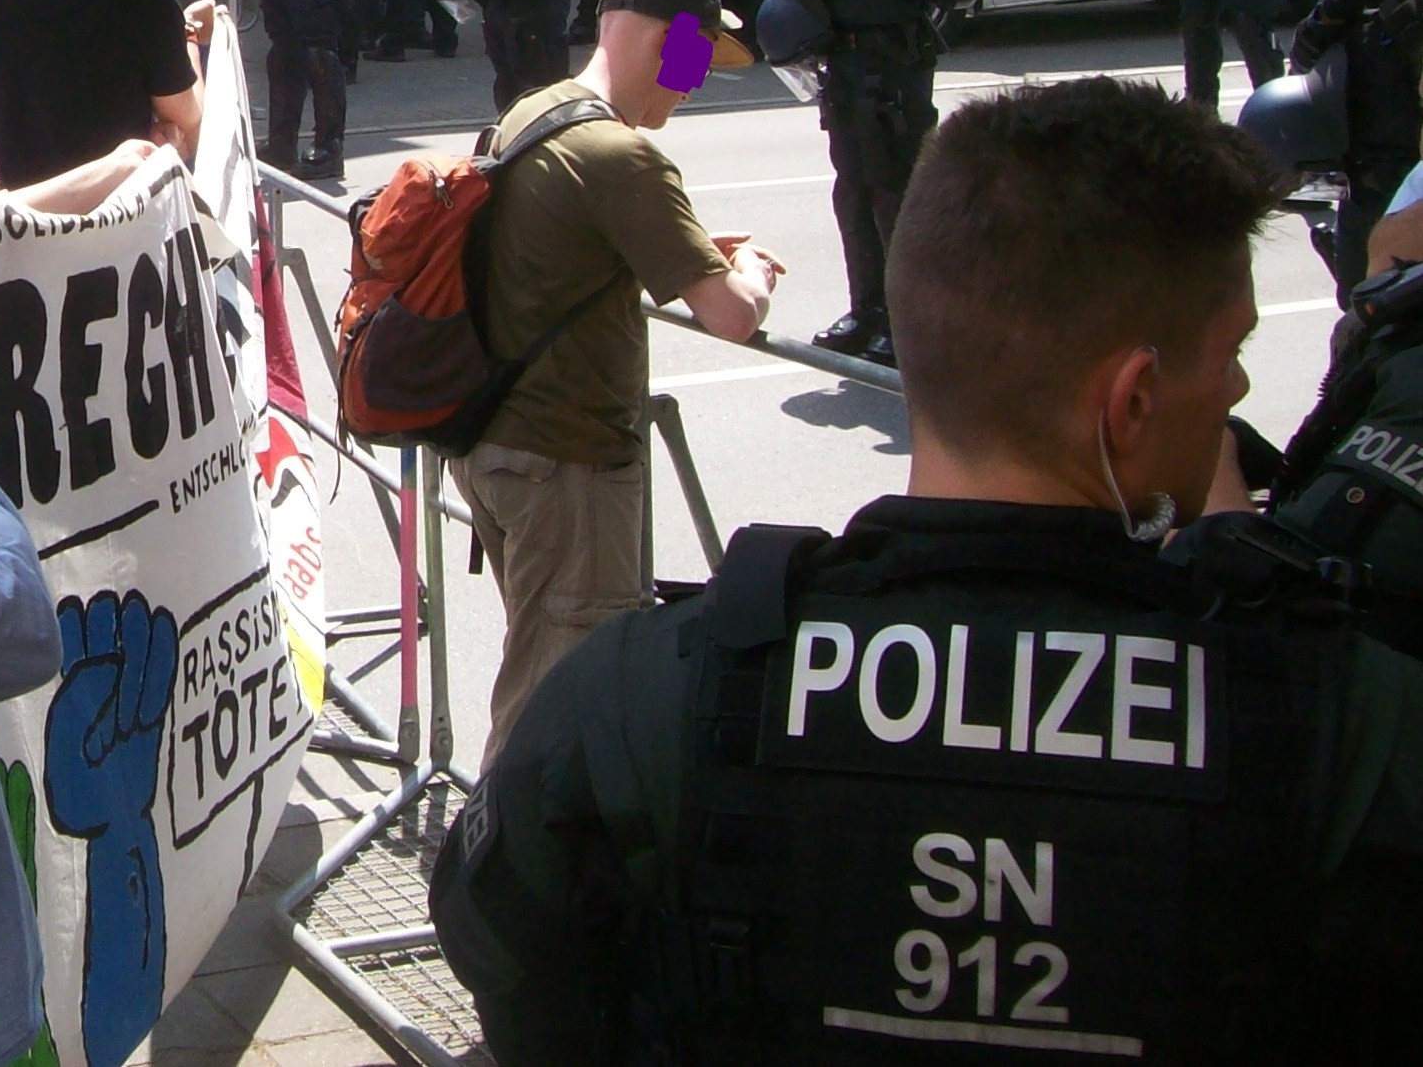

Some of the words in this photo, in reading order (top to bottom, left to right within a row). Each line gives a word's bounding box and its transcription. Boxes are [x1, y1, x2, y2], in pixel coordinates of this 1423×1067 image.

[1337, 424, 1423, 494] POLIZ
[787, 620, 1206, 770] POLIZEI
[909, 832, 1055, 927] SN
[893, 929, 1070, 1023] 912
